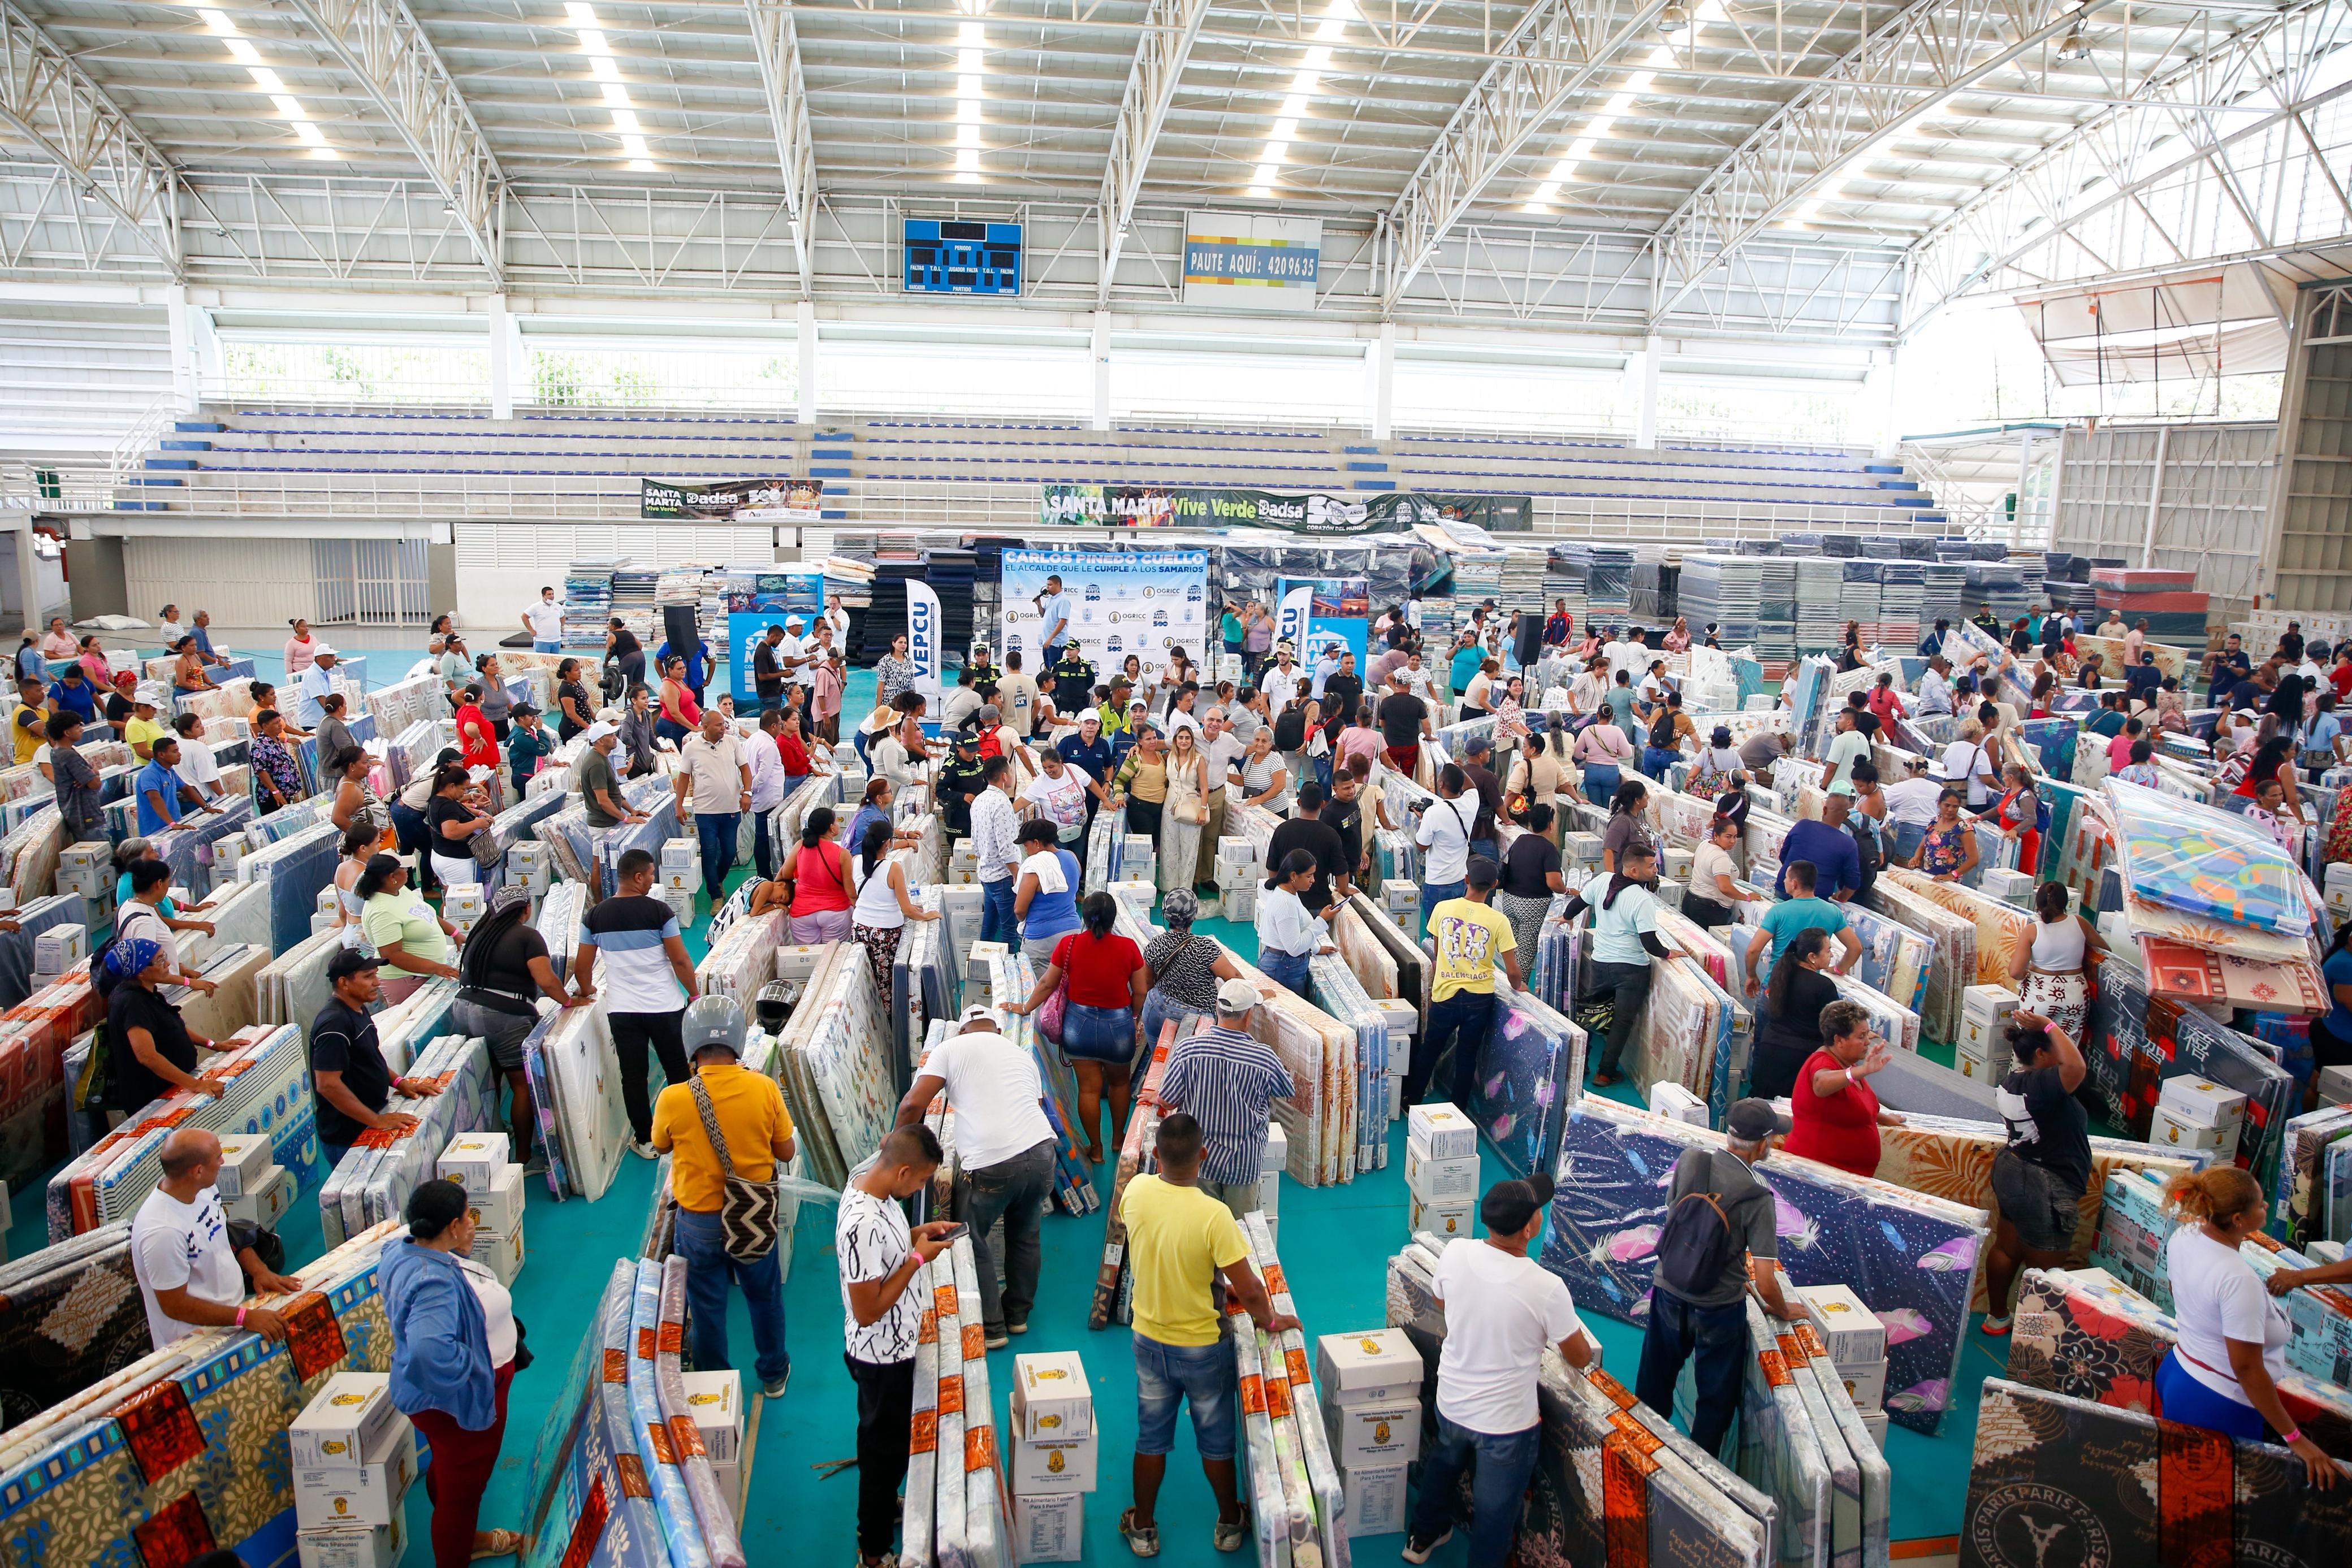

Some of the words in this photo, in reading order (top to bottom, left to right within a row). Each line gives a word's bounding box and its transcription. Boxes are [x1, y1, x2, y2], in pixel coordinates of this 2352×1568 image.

[1191, 252, 1223, 271] PAUTE
[1229, 250, 1261, 274] AQUÍ:
[646, 488, 680, 497] SANTA
[646, 497, 682, 507] MARTA
[686, 492, 738, 505] Dadsa
[1050, 495, 1107, 516] SANTA
[1112, 497, 1170, 516] MARTA
[1173, 498, 1207, 516] Vive
[1211, 499, 1256, 519] Verde
[1259, 499, 1303, 519] Dadsa
[1005, 551, 1073, 564] CARLOS
[1076, 553, 1136, 564] PINEDO
[1140, 553, 1205, 564] CUELLO
[913, 601, 928, 677] VEPCU
[1441, 971, 1488, 980] BALENCIAGA
[1978, 1489, 2016, 1525] PARIS
[2018, 1487, 2074, 1510] PARIS
[2073, 1508, 2106, 1554] PARIS
